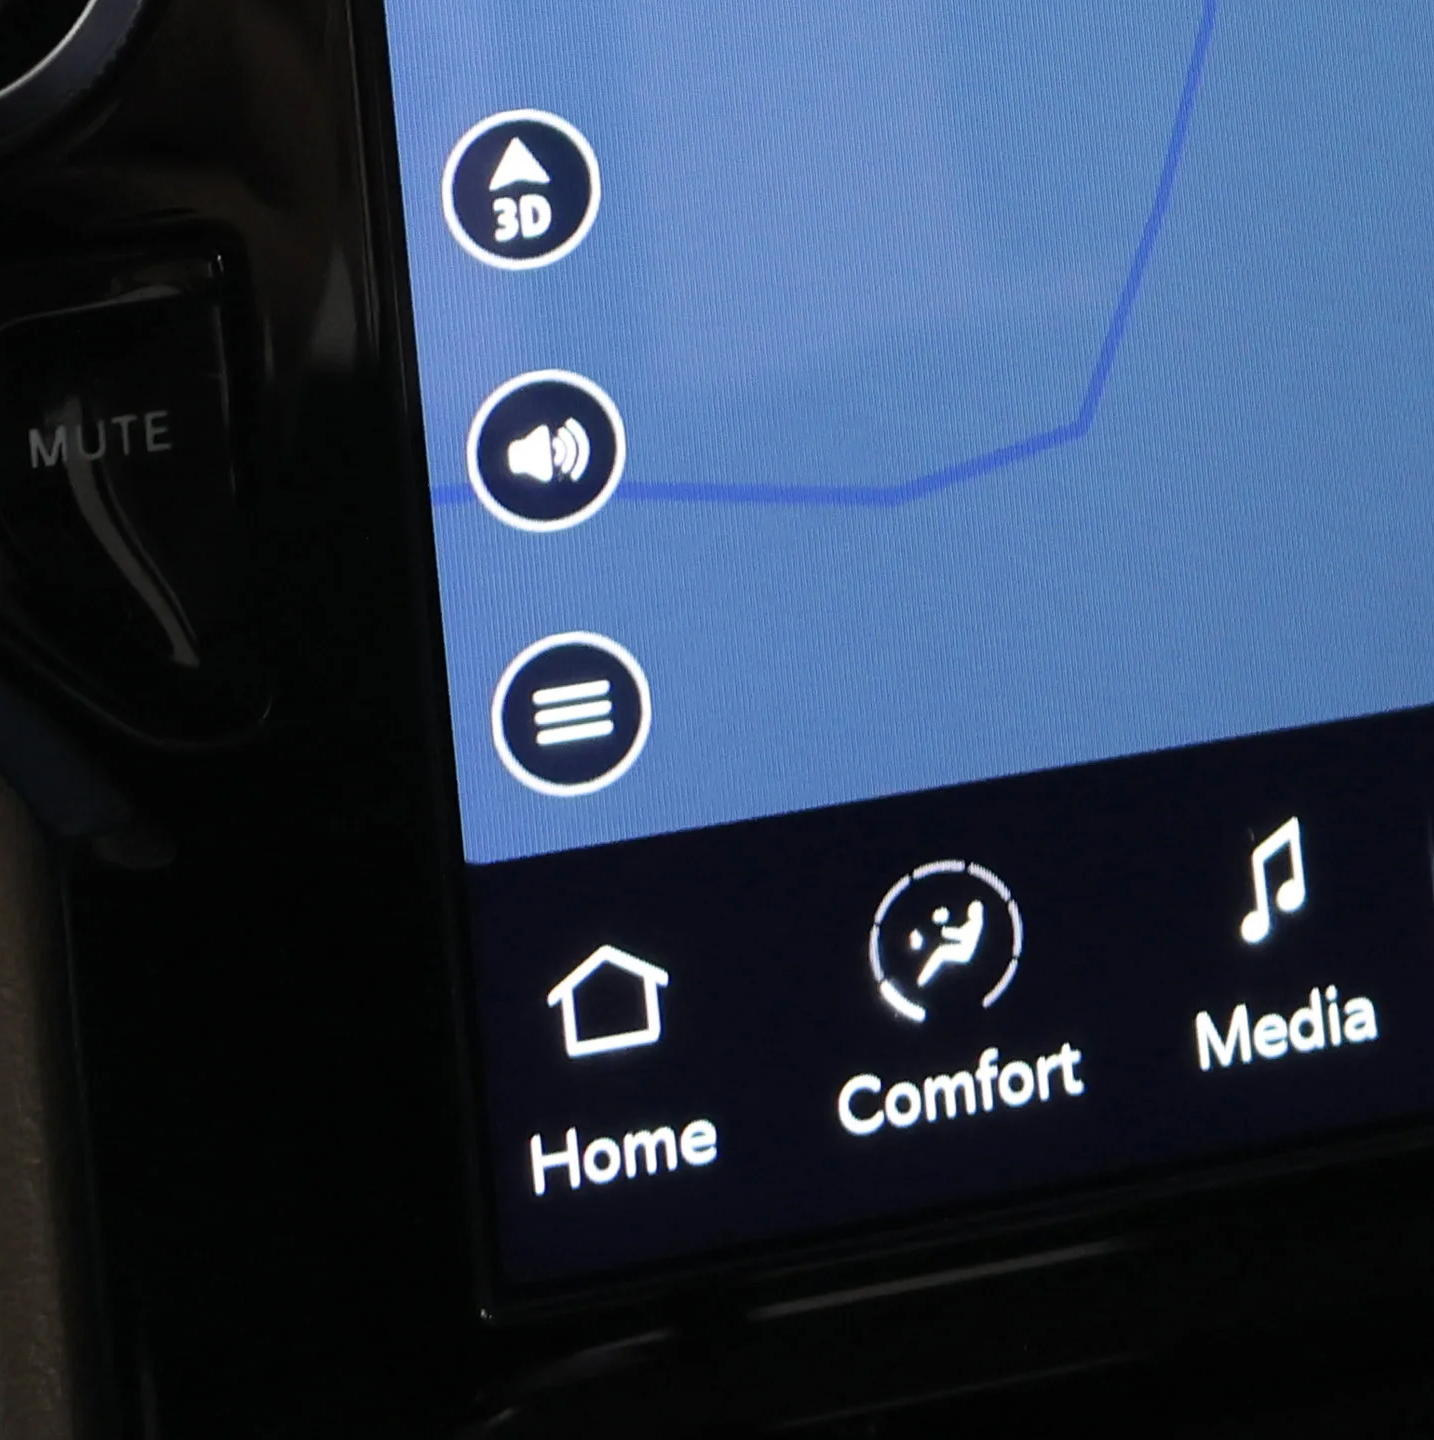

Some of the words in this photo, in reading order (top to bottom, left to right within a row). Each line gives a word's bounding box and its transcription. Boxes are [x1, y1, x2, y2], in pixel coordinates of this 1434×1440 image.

[491, 192, 553, 244] 3D
[27, 410, 172, 470] MUTE
[1194, 983, 1379, 1072] Media
[836, 1041, 1085, 1136] Comfort
[529, 1118, 718, 1196] Home
